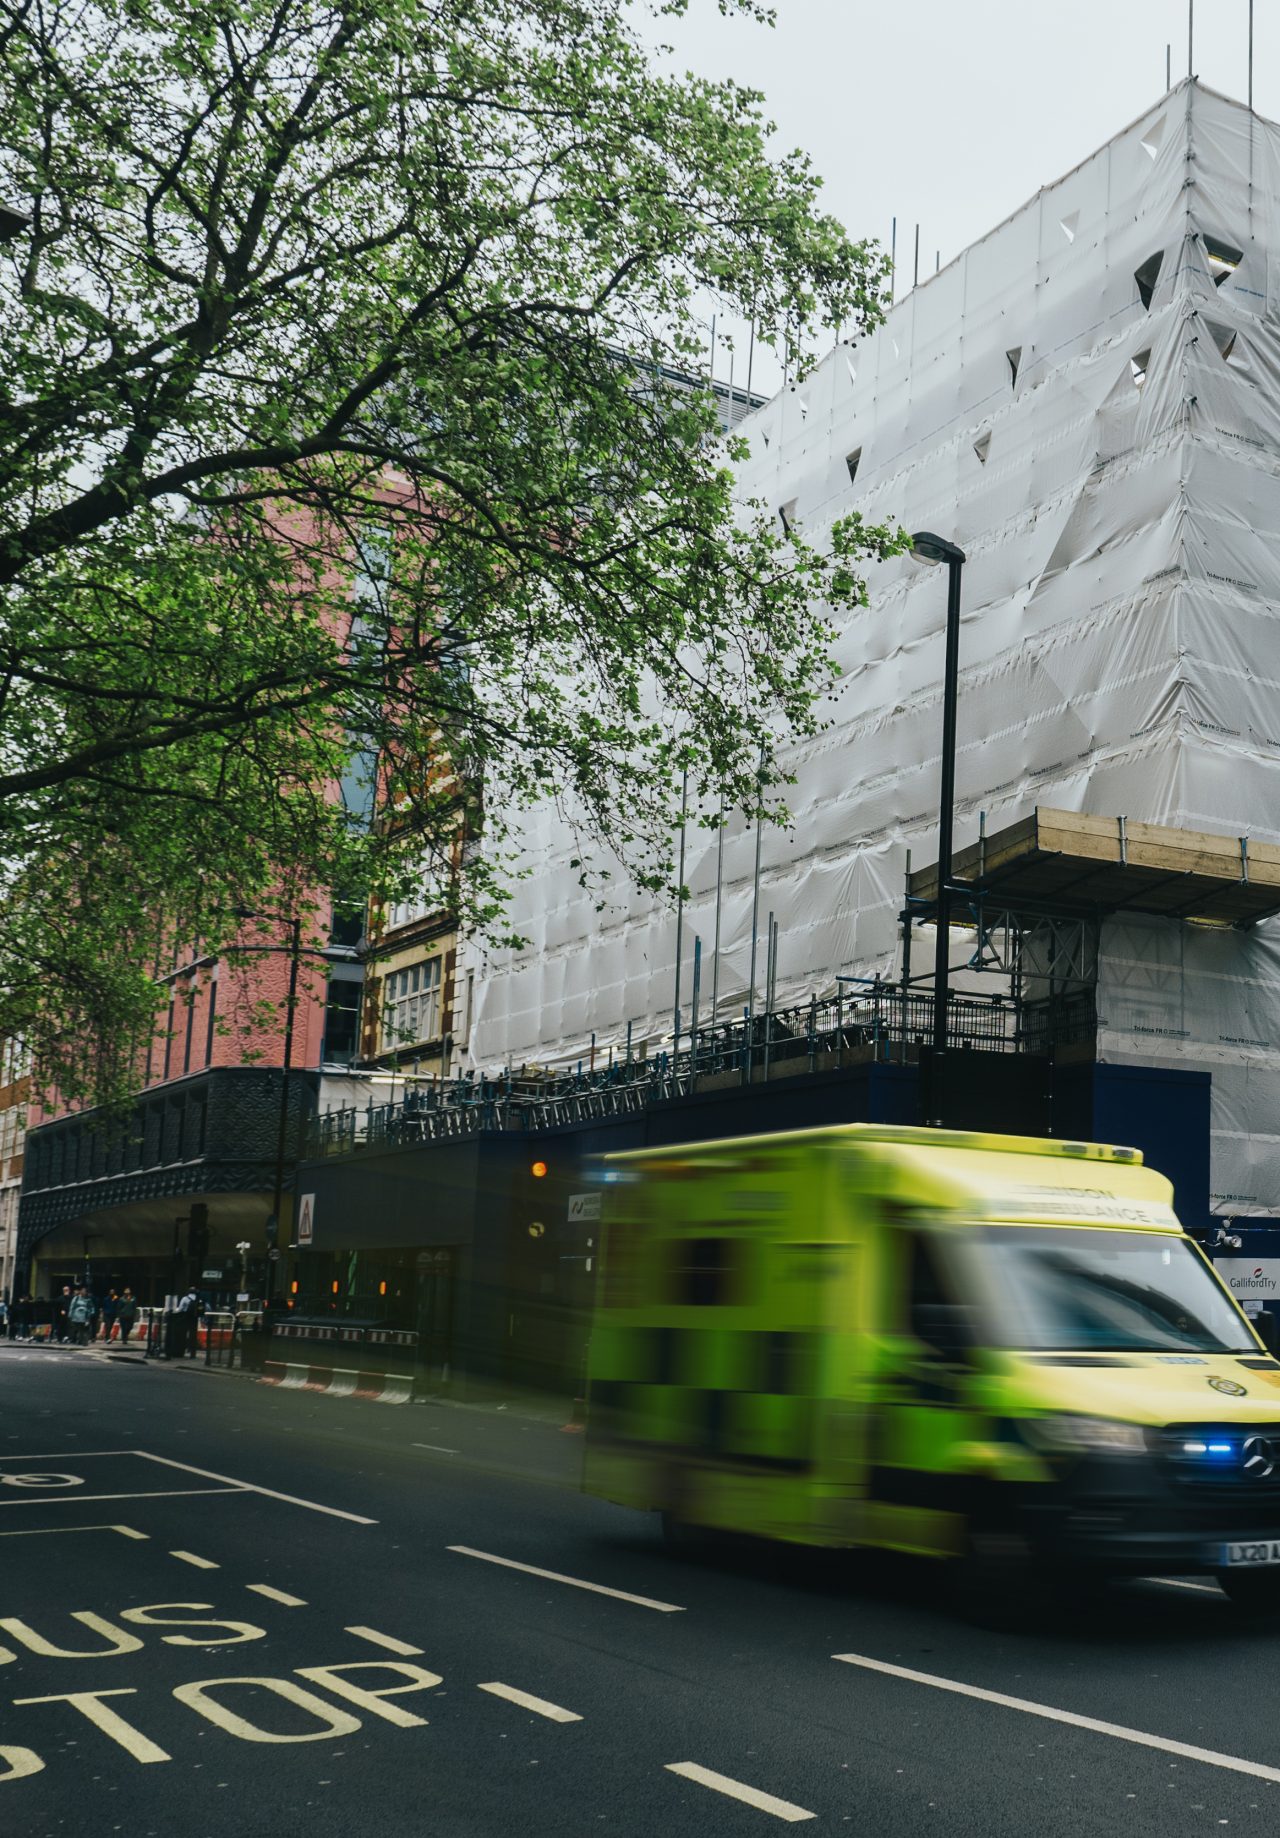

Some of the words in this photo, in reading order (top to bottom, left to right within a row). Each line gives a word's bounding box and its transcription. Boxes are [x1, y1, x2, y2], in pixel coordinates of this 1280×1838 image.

[1134, 1025, 1155, 1033] Tri-force
[1229, 1277, 1277, 1290] GallifordTry
[1229, 1543, 1269, 1563] LX20
